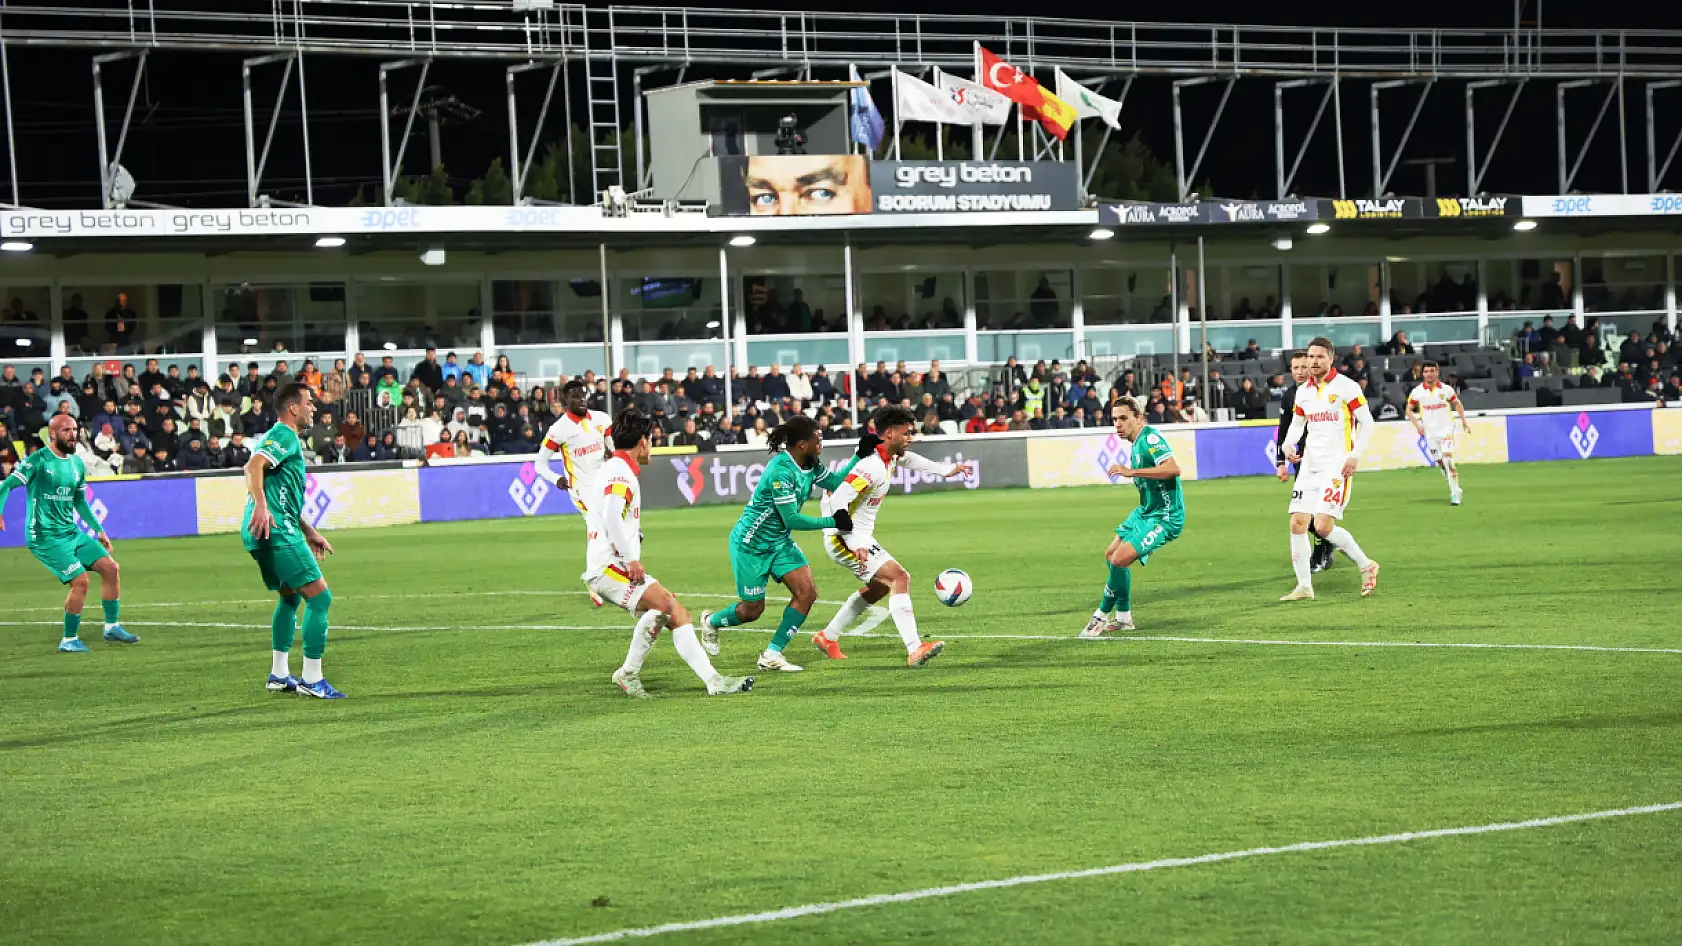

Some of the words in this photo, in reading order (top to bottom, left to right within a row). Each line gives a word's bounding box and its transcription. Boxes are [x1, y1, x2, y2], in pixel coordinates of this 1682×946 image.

[896, 165, 957, 187] grey
[960, 162, 1032, 183] beton
[878, 195, 956, 211] BODRUM
[957, 194, 1052, 210] STADYUMU
[1355, 199, 1405, 211] TALAY
[1459, 197, 1507, 210] TALAY
[1650, 196, 1682, 214] ope
[10, 214, 71, 233] grey
[80, 211, 155, 229] beton
[173, 212, 231, 232] grey
[239, 209, 310, 227] beton
[1323, 488, 1341, 505] 24
